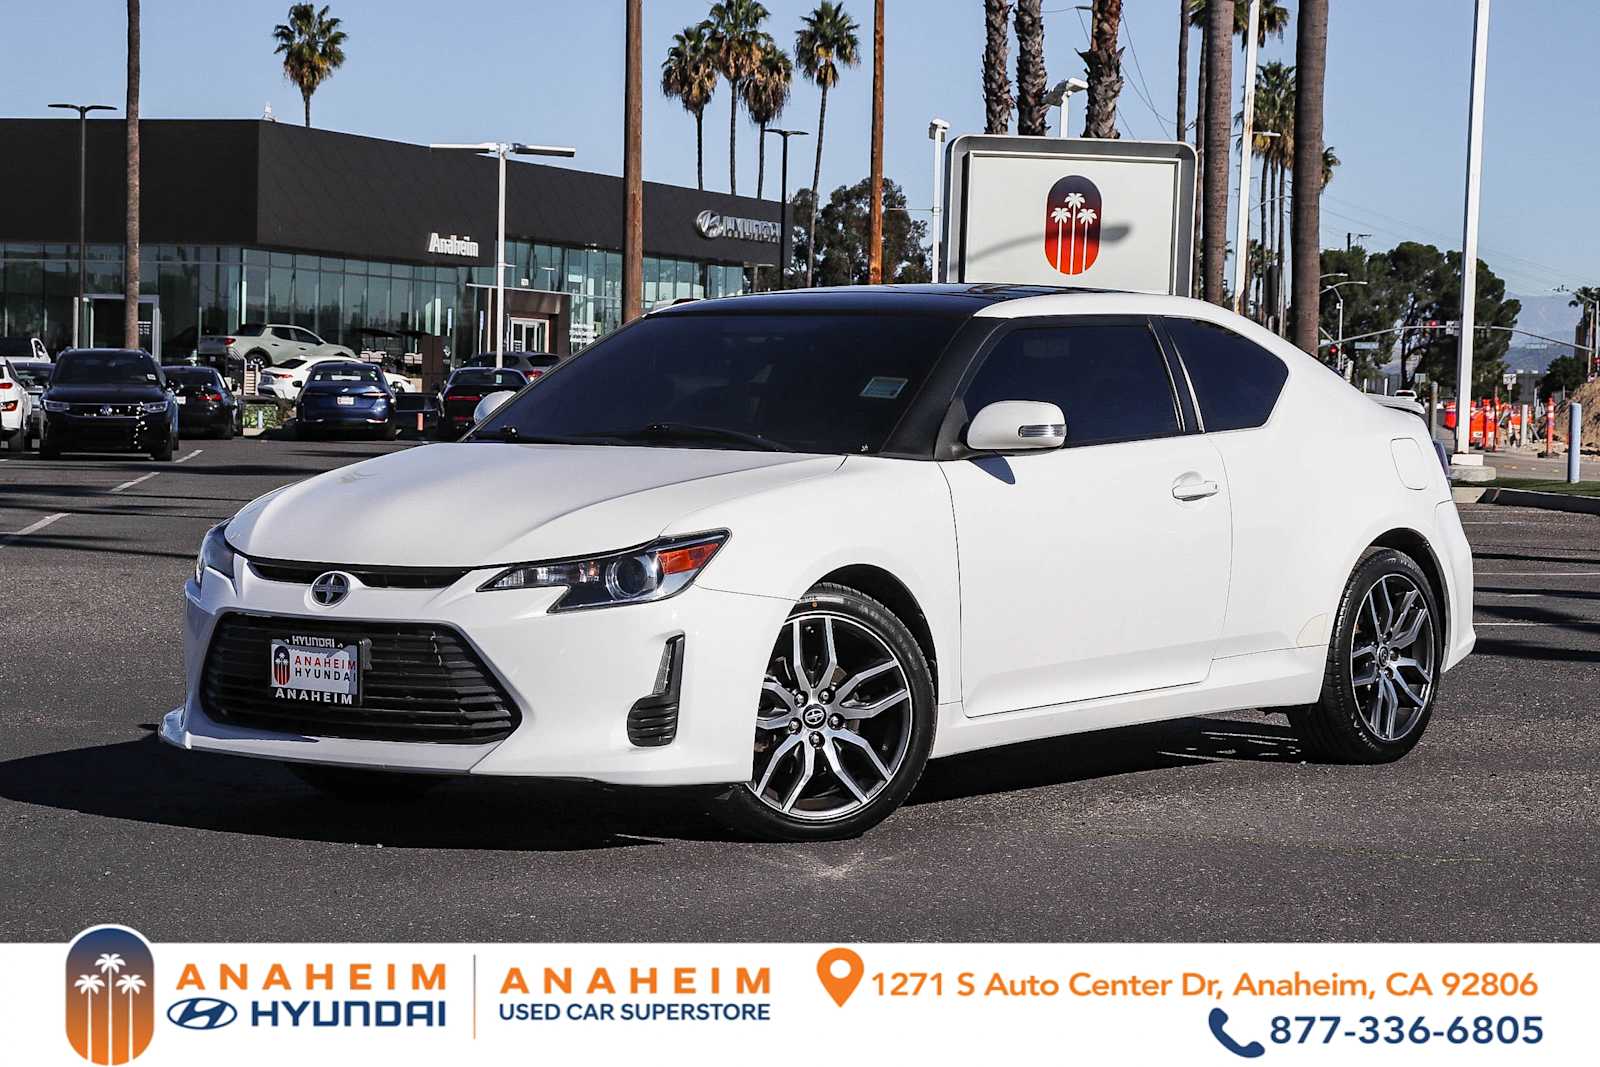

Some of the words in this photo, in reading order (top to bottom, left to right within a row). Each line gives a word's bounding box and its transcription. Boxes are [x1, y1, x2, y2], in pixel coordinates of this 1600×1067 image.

[428, 232, 479, 257] Anaheim
[291, 635, 335, 648] HYUNDAI
[294, 655, 356, 671] ANAHEIM
[294, 668, 356, 683] HYUNDAI
[275, 687, 352, 704] ANAHEIM
